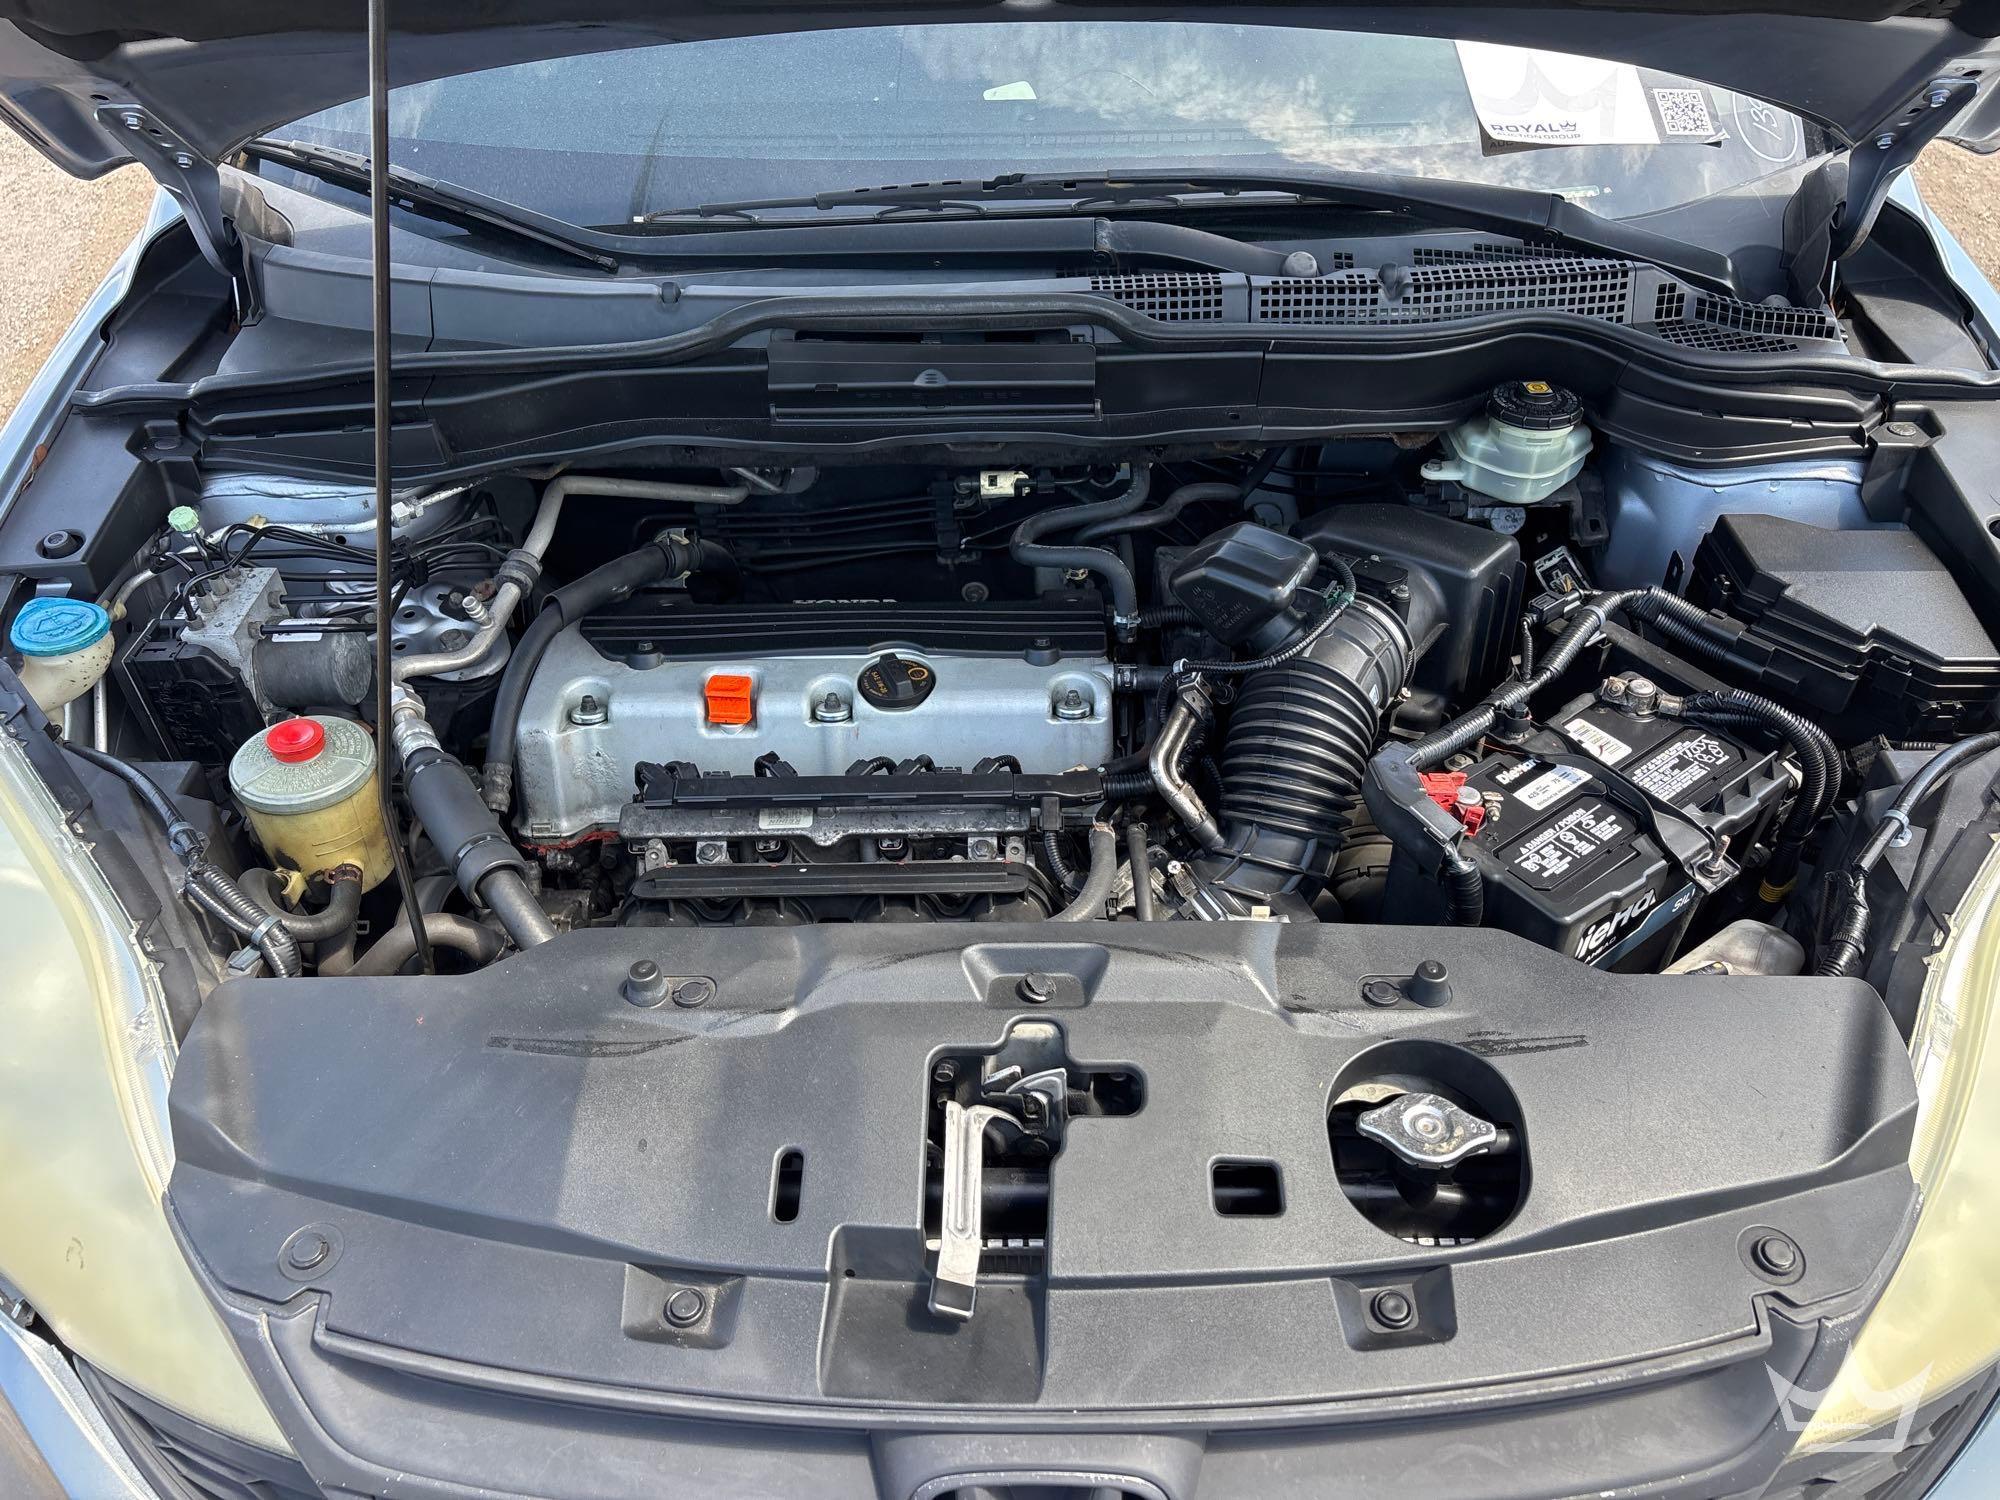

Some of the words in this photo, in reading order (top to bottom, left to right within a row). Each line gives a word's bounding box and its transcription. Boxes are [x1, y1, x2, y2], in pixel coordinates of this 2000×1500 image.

[1490, 123, 1560, 133] ROYAL
[1543, 132, 1581, 140] GROUP
[1524, 828, 1557, 850] DANGER
[1558, 808, 1587, 828] POISON
